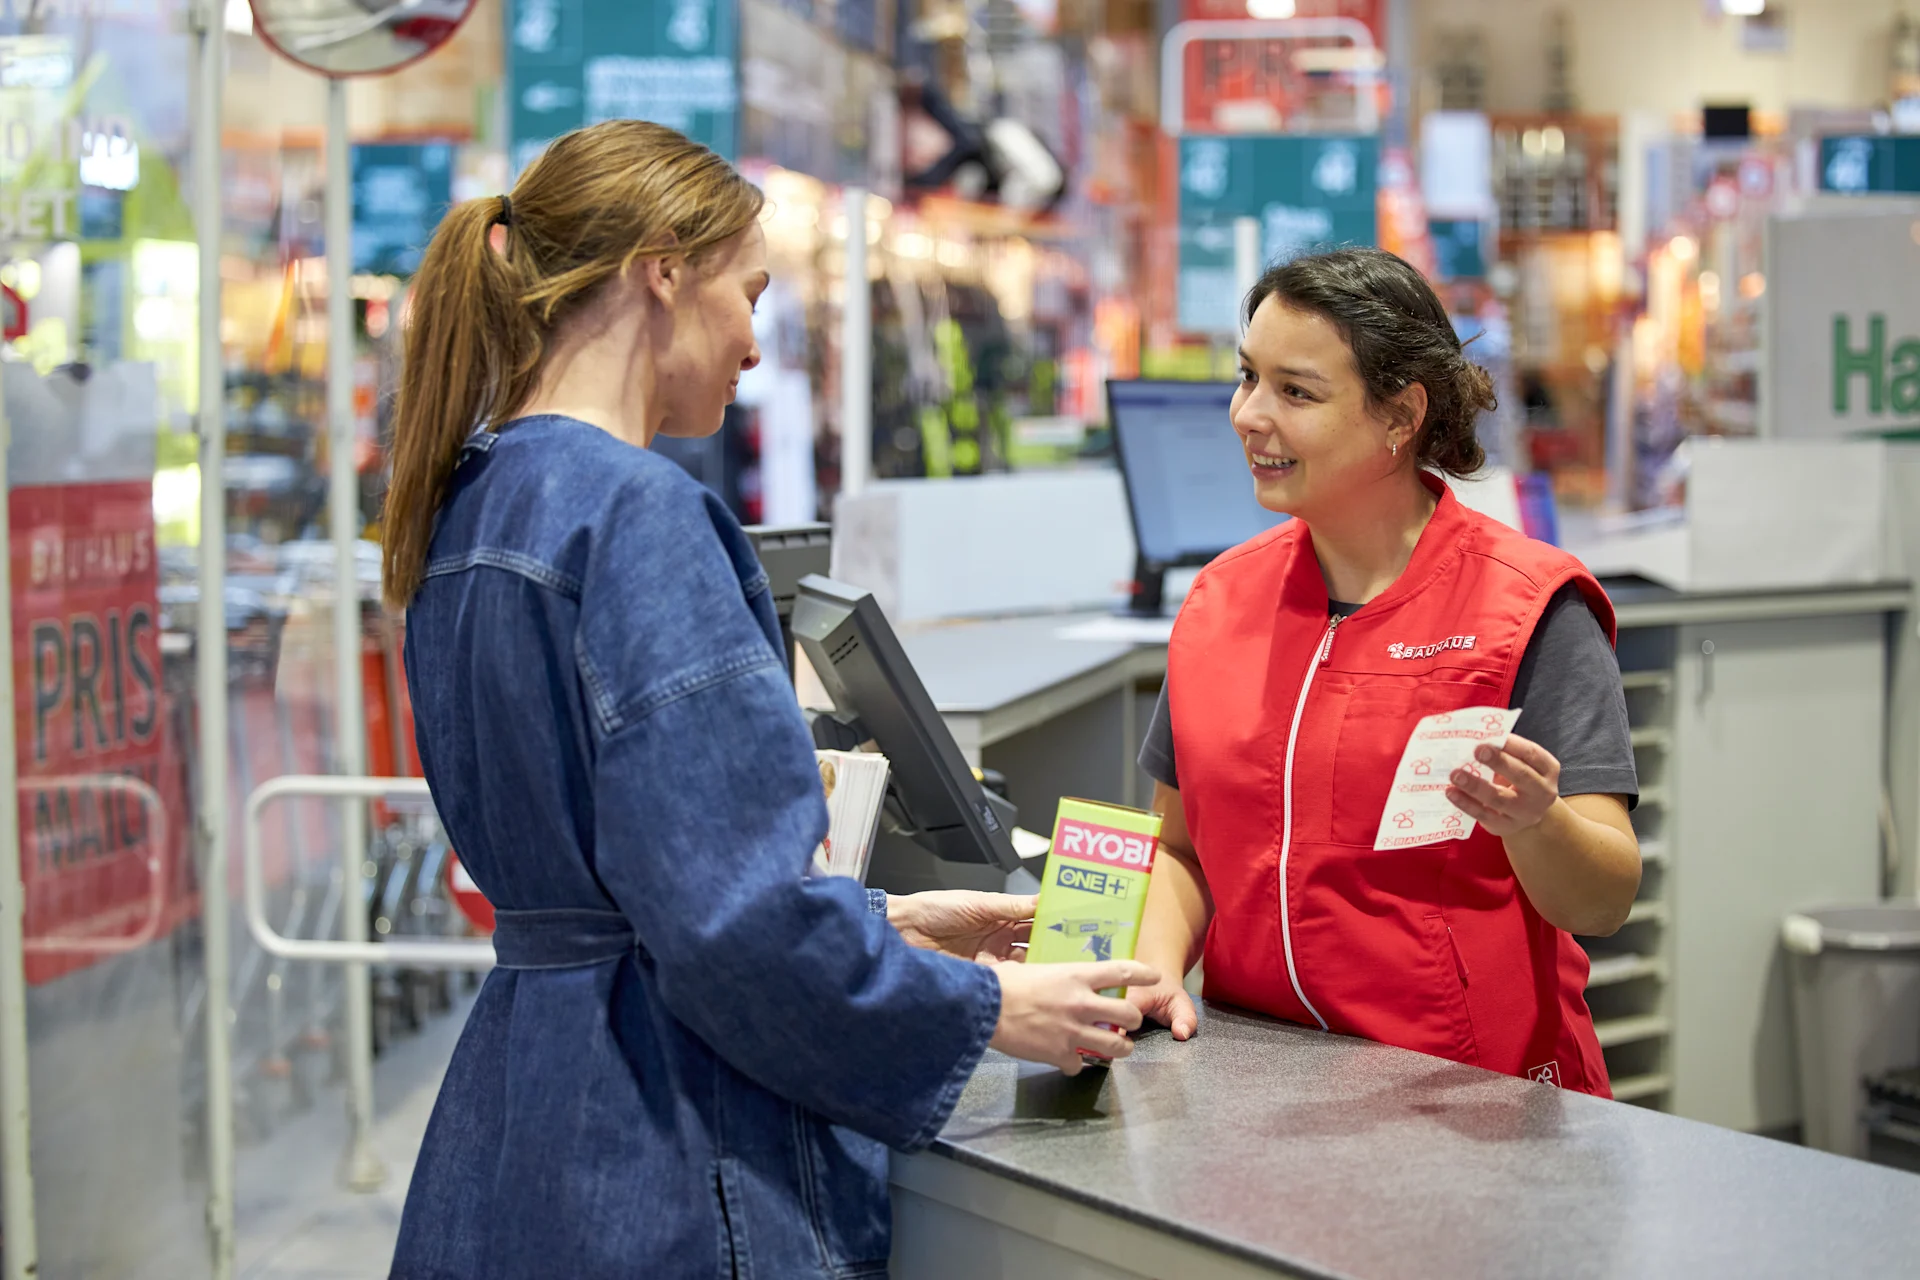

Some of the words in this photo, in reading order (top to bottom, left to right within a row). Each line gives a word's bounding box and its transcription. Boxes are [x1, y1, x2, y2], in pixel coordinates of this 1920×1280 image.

[1402, 636, 1476, 659] BAUHAUS
[33, 606, 155, 764] PRIS
[1062, 825, 1153, 867] RYOBI
